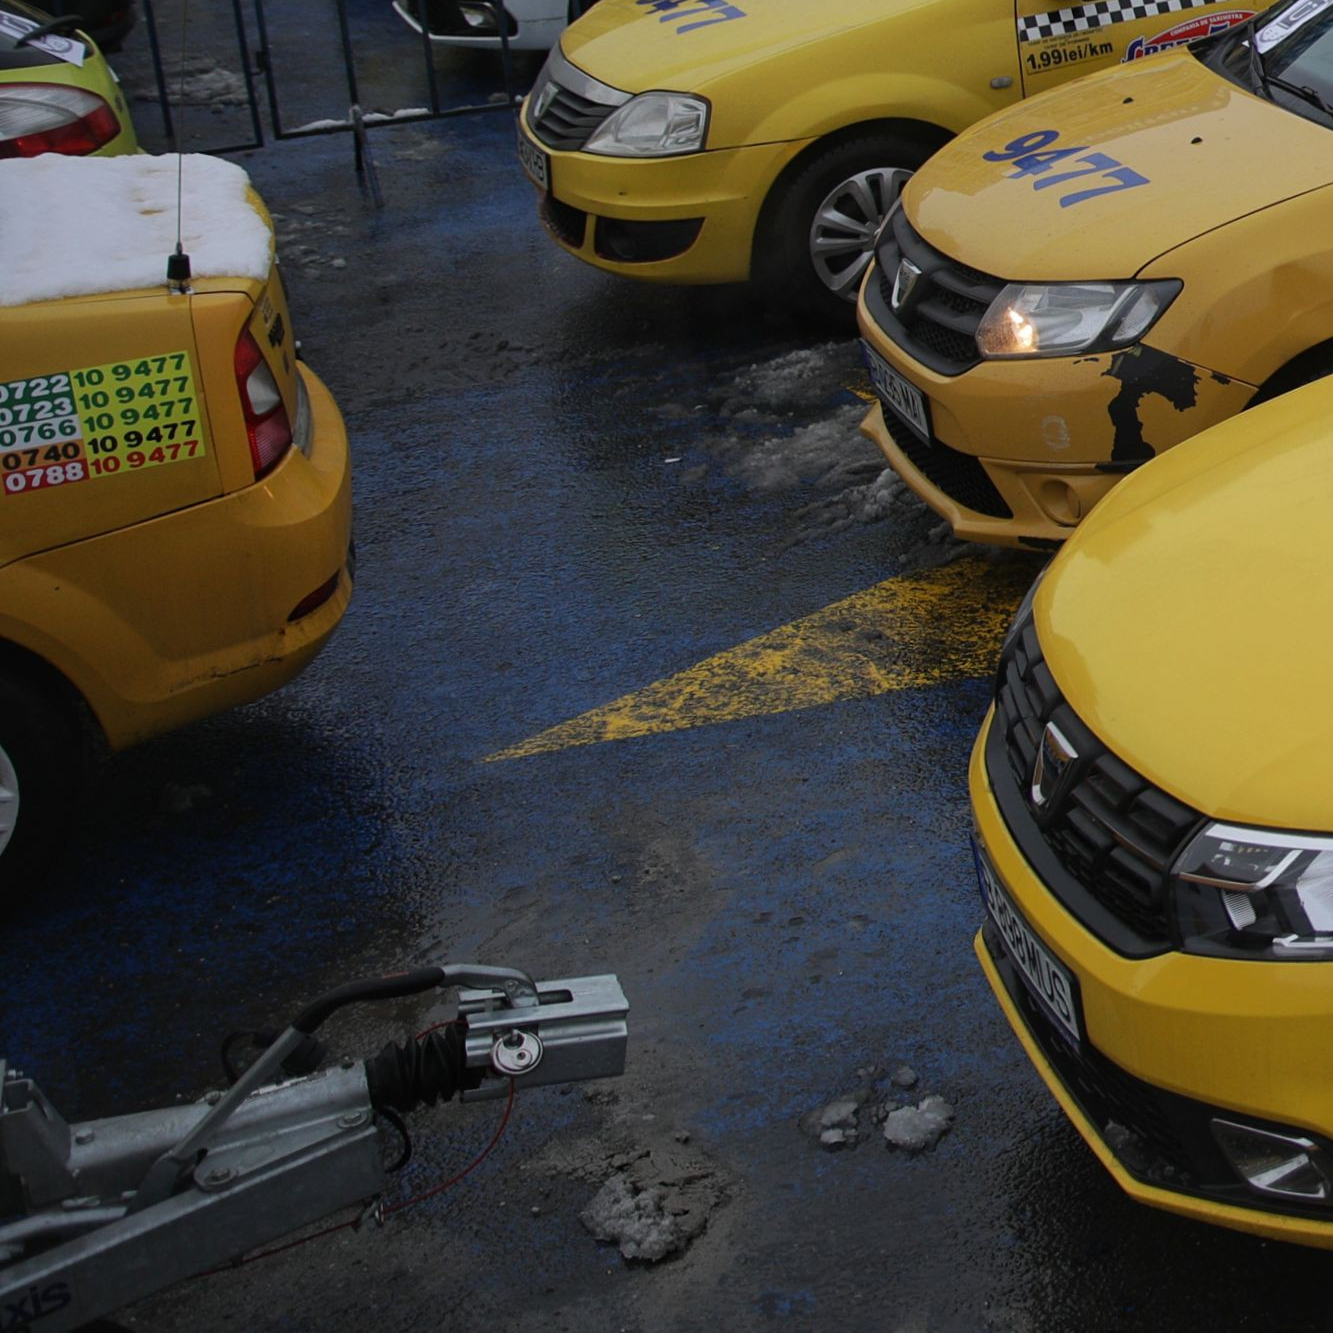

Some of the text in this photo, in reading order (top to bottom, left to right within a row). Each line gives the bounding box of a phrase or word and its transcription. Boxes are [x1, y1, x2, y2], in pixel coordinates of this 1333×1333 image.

[982, 130, 1151, 208] 9477
[74, 369, 104, 387] 10
[111, 354, 185, 381] 9477
[0, 376, 189, 426] 0723 10 9477
[0, 397, 193, 447] 0766 10 9477
[2, 420, 196, 470] 0740 10 9477
[5, 440, 199, 492] 0788 10 9477
[2, 1282, 71, 1333] xis
